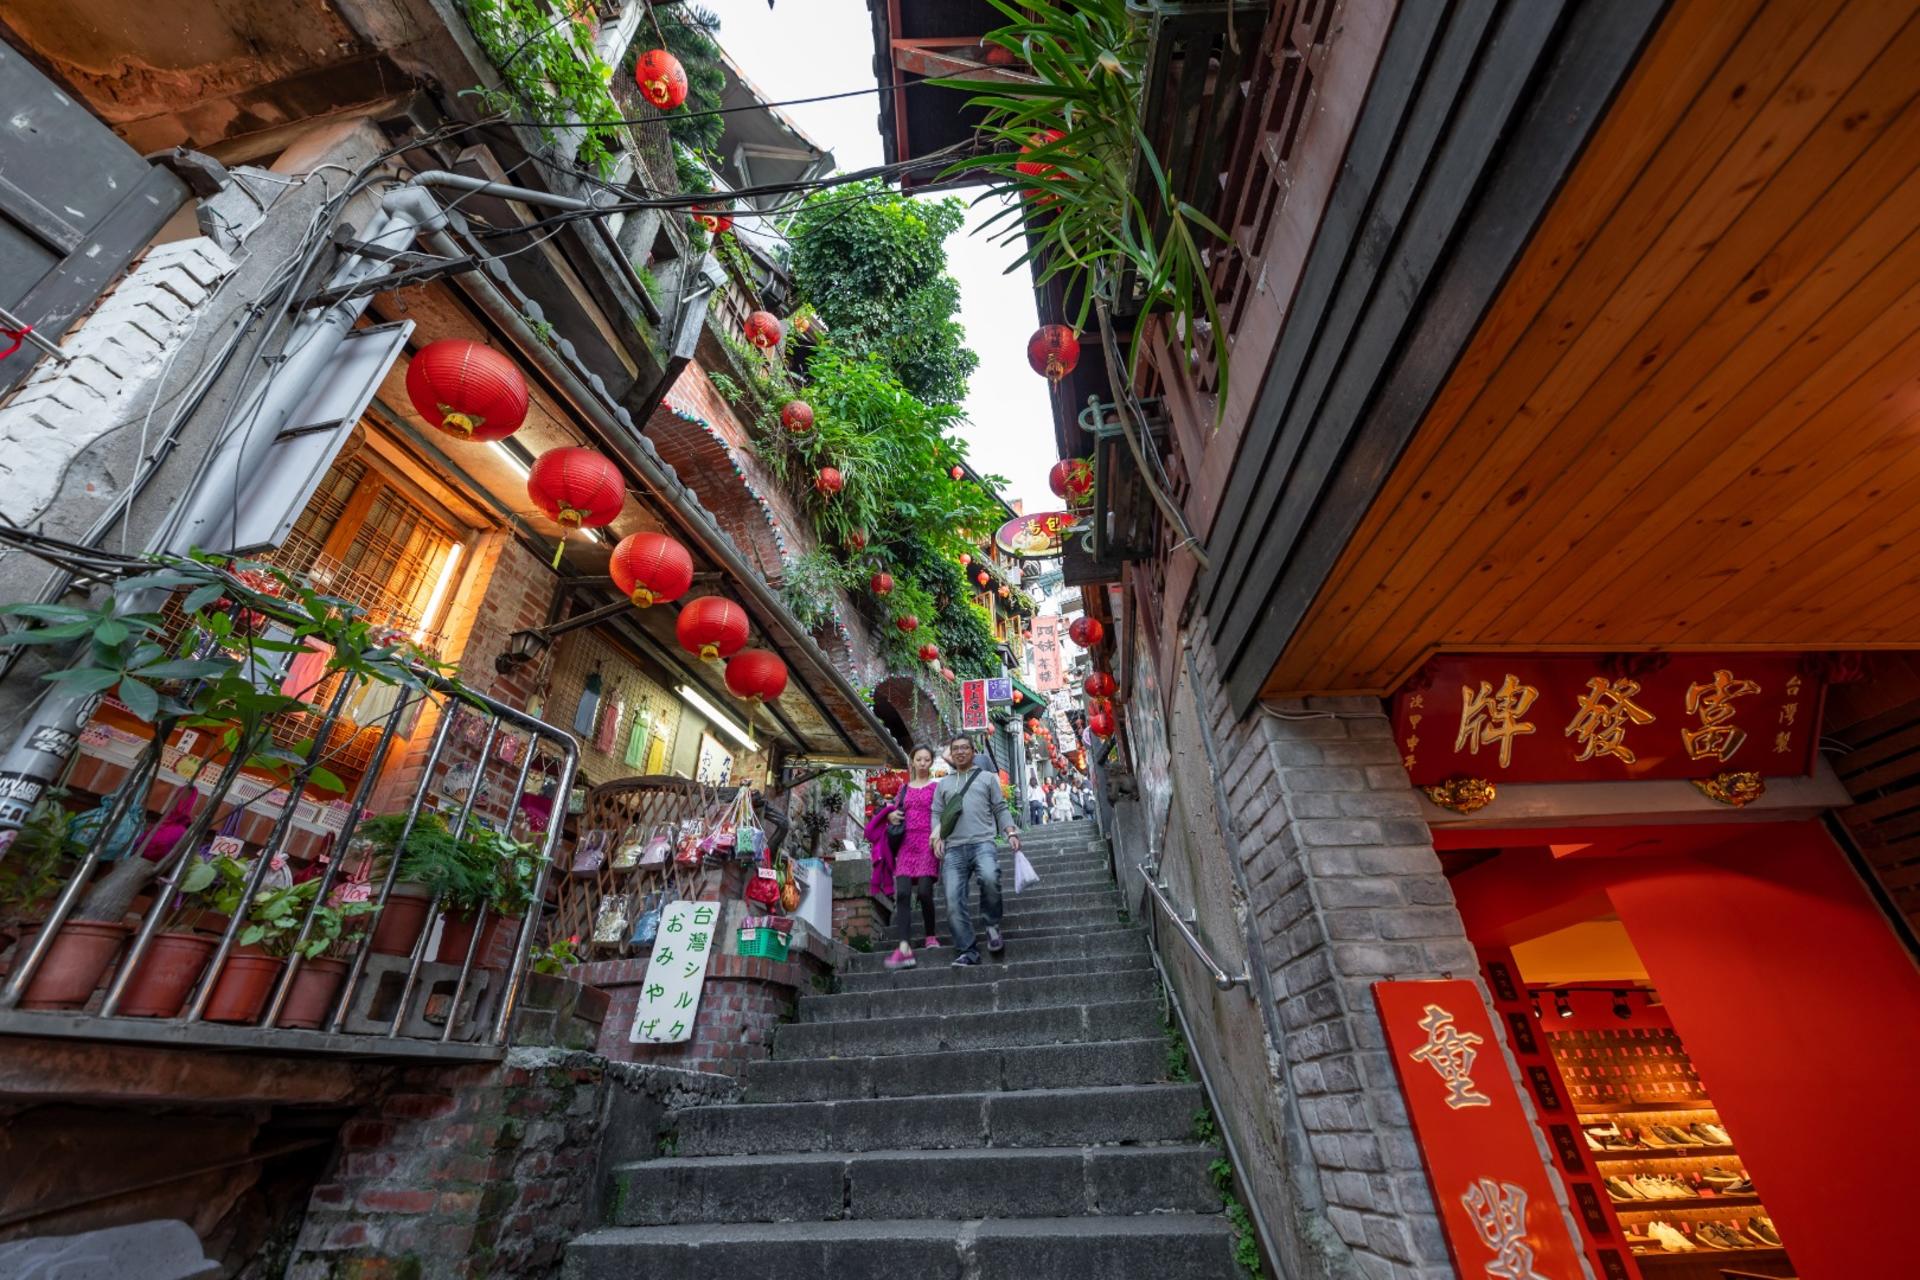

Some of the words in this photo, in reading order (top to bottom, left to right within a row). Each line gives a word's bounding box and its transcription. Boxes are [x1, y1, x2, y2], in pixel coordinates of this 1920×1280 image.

[638, 912, 686, 1040] おみやげ
[669, 906, 714, 1040] 台灣シルク
